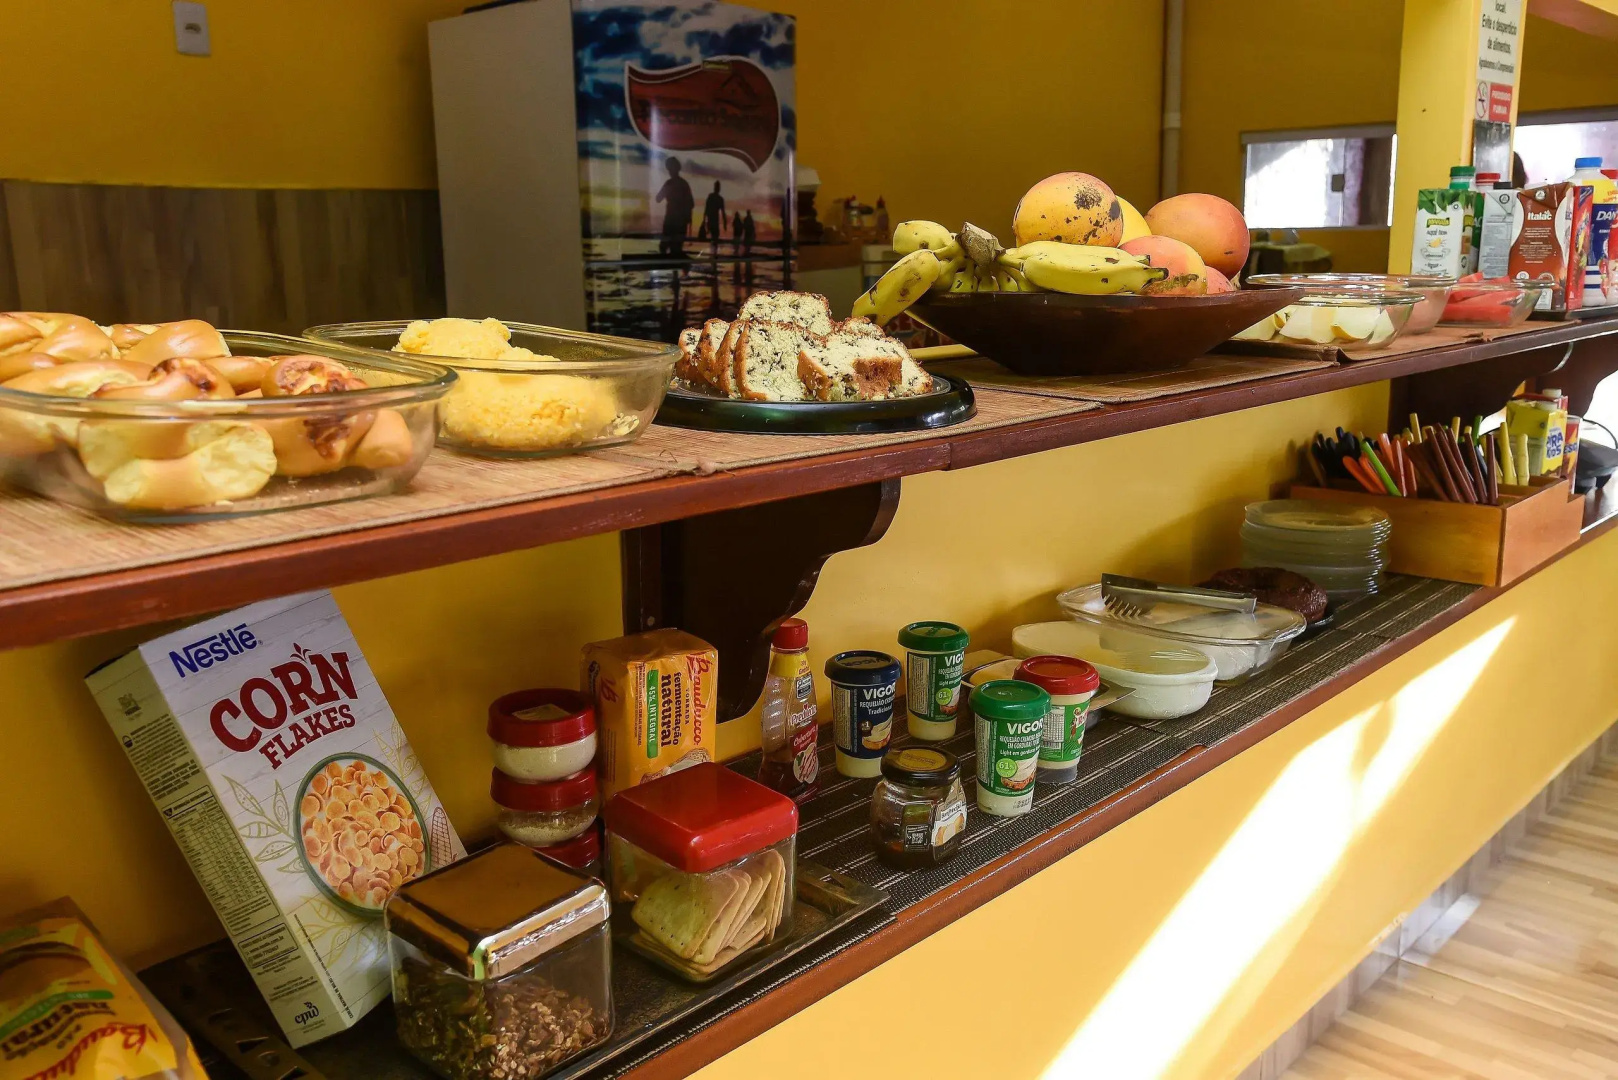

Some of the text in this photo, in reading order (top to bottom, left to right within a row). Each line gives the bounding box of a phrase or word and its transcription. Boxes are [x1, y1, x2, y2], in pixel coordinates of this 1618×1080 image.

[168, 622, 258, 679] Nestlé
[945, 651, 965, 667] VIGO
[209, 651, 358, 753] CORN
[648, 703, 657, 743] INTEGRAL
[660, 674, 673, 748] natural
[672, 671, 682, 746] fermentação
[685, 650, 712, 746] Bauducco
[1006, 717, 1044, 735] VIGOR
[258, 703, 356, 771] FLAKES
